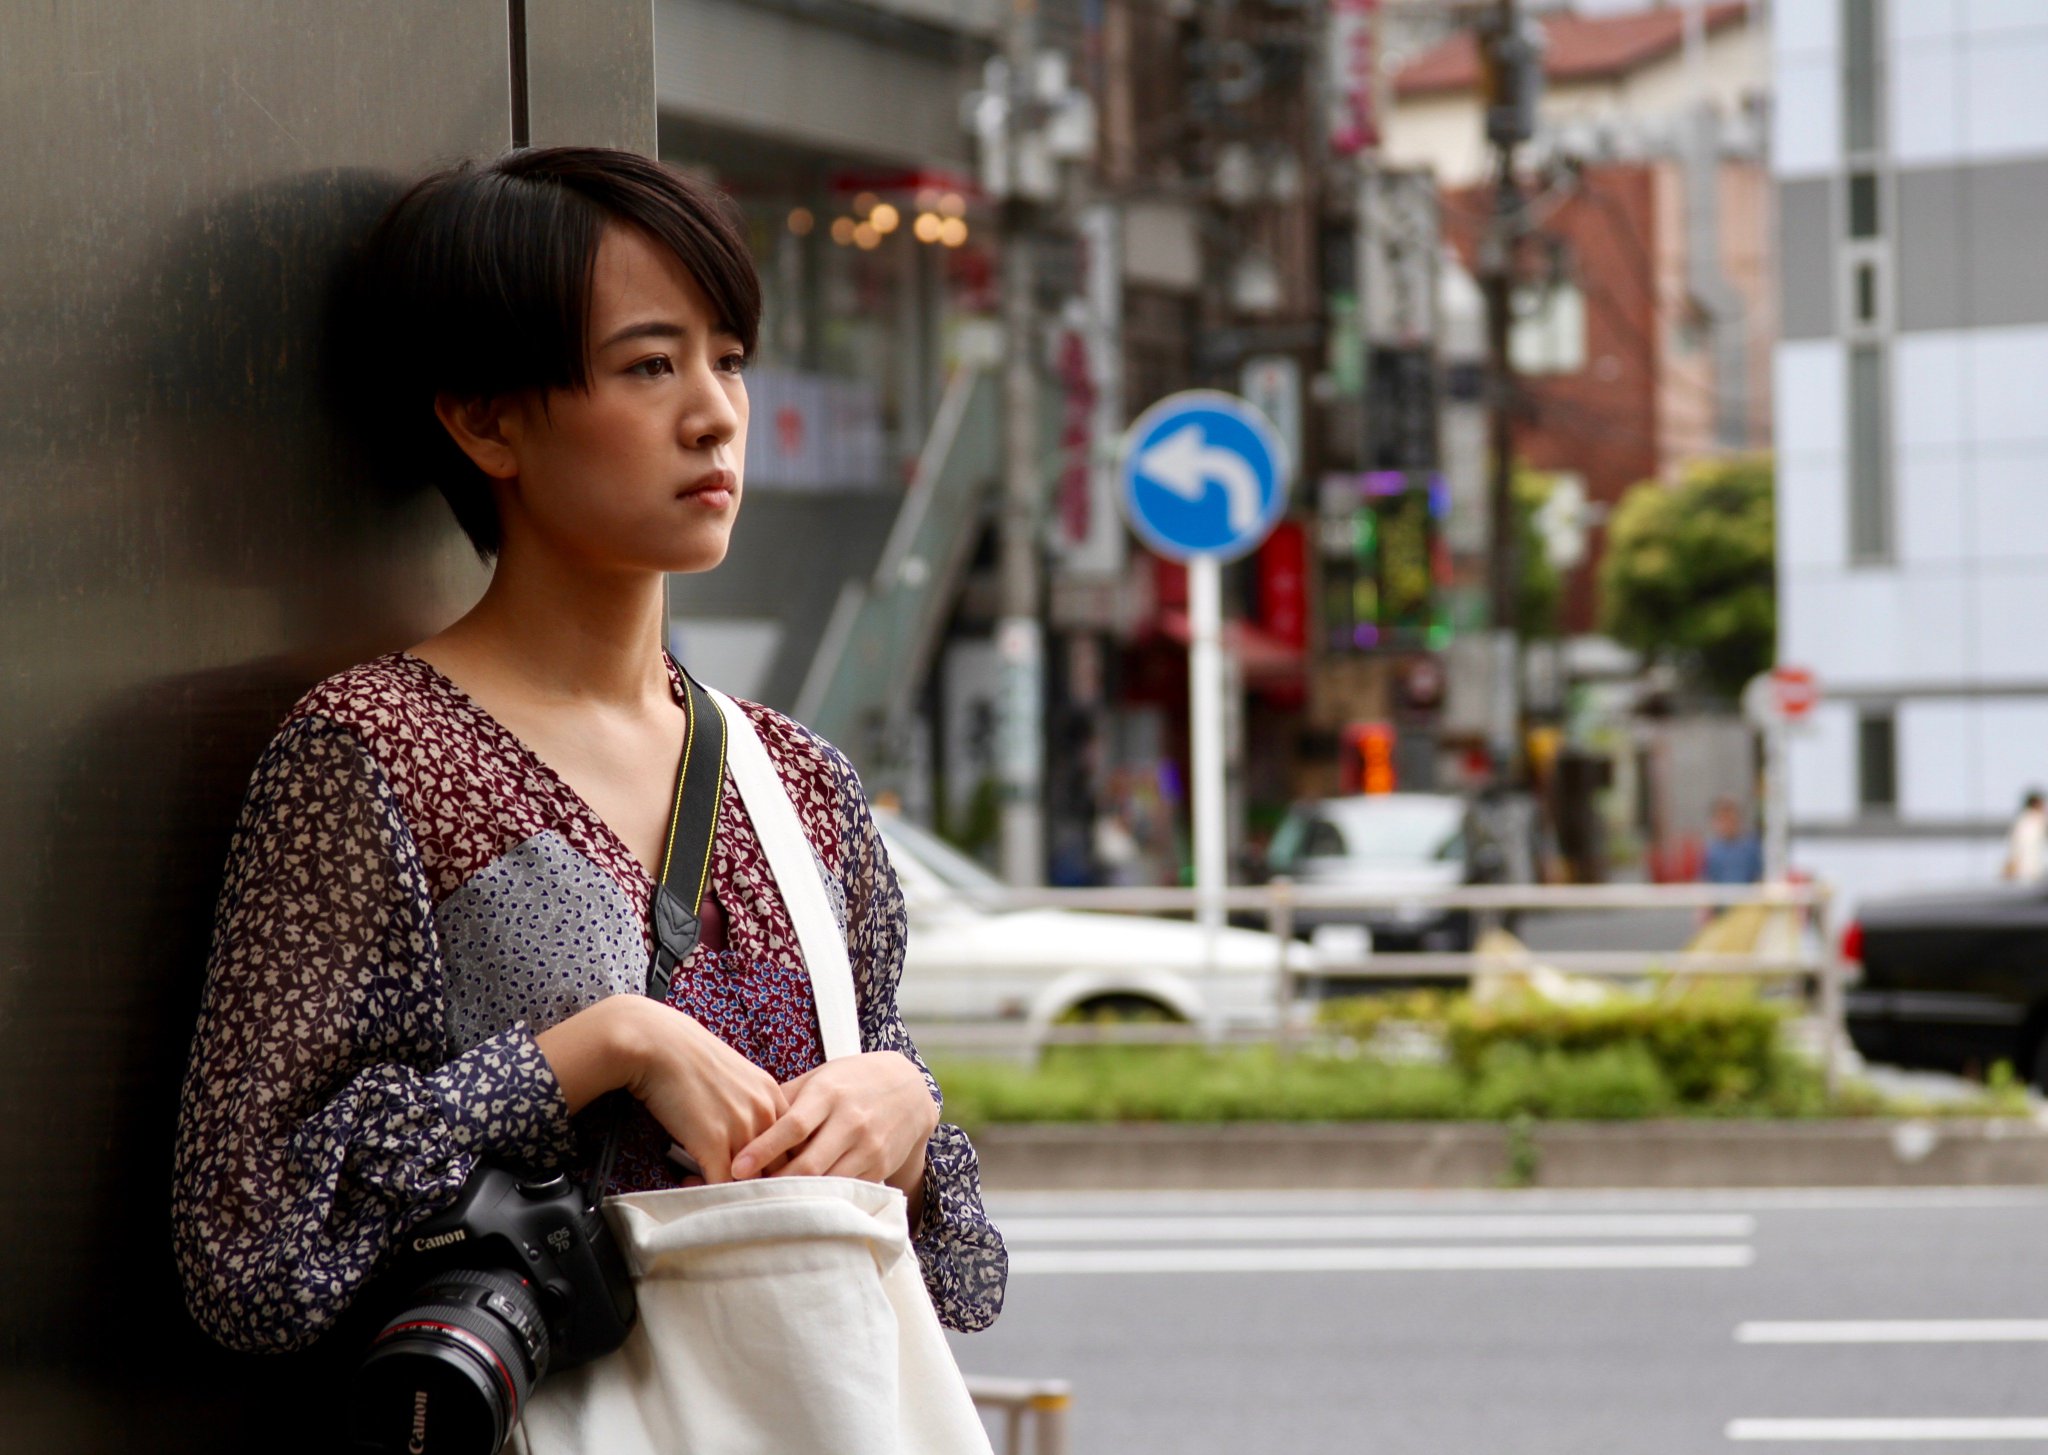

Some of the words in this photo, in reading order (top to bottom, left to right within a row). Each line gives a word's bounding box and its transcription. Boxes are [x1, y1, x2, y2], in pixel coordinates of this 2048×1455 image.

[413, 1228, 466, 1252] Canon
[547, 1226, 570, 1245] EOS
[555, 1240, 570, 1253] 7D
[408, 1391, 428, 1454] Canon
